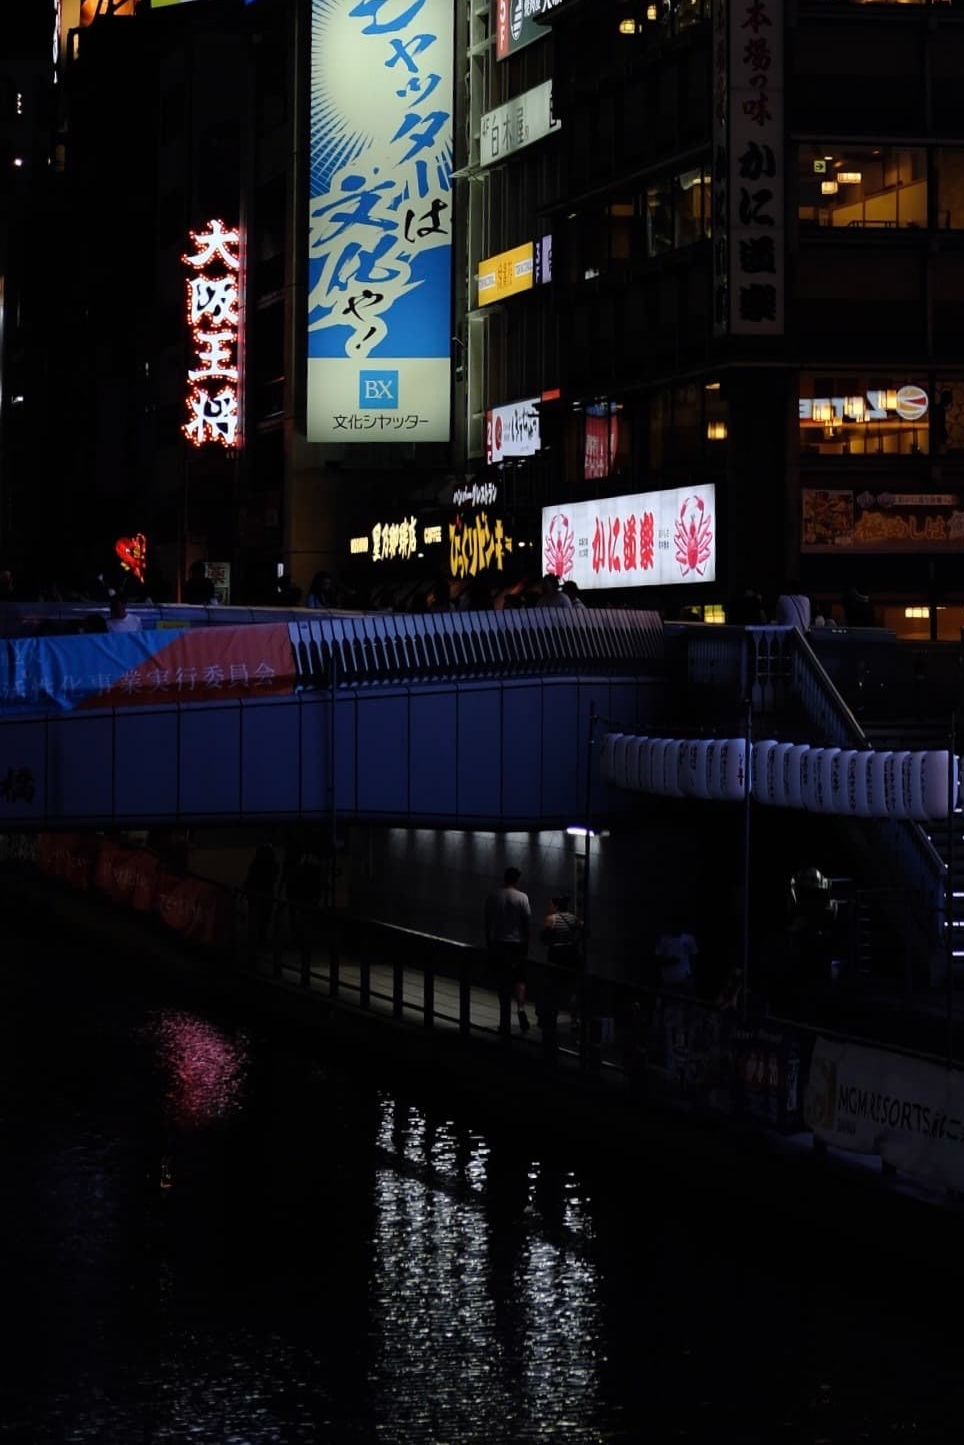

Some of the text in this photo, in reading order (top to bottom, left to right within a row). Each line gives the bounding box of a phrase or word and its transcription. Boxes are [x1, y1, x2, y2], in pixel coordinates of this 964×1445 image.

[186, 218, 241, 446] 大阪王将
[364, 380, 393, 400] BX
[332, 413, 429, 431] 文化シャッター
[449, 510, 513, 579] びっくりドンキー
[838, 1086, 867, 1120] MGM
